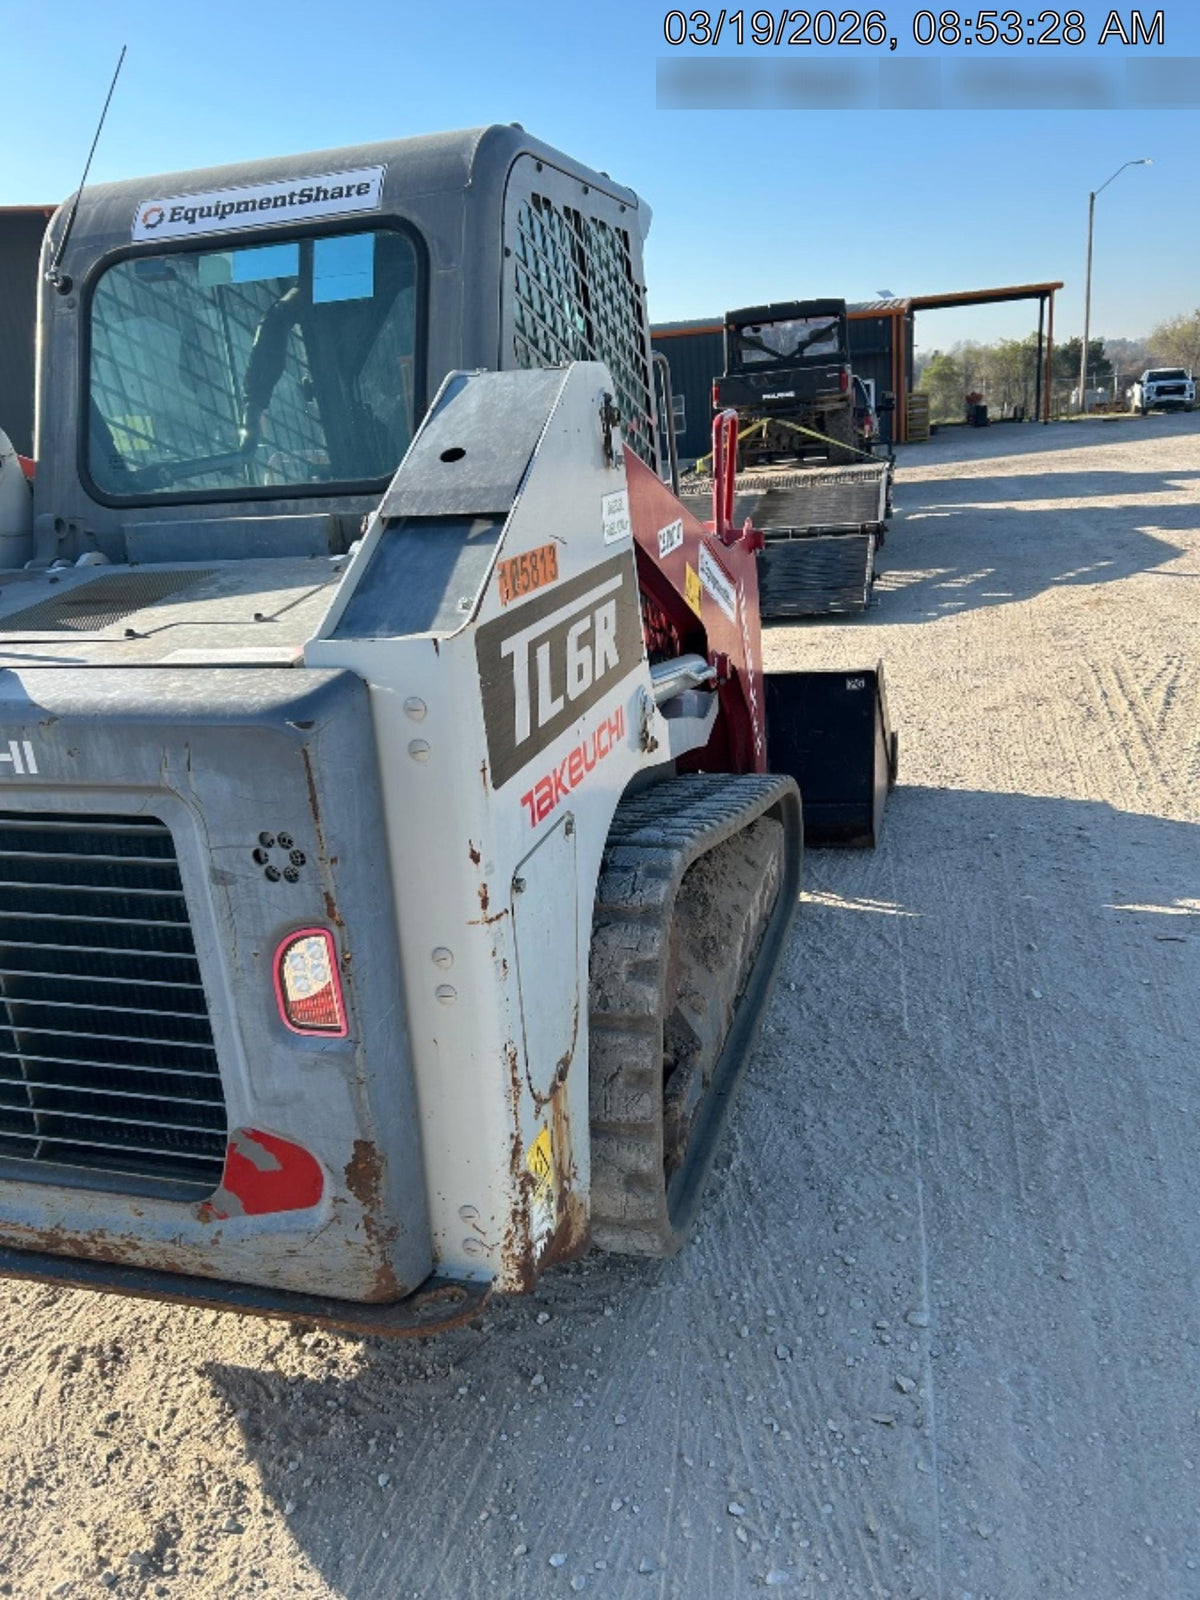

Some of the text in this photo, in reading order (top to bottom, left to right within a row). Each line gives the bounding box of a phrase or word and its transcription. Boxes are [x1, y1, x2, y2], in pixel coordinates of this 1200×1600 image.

[168, 181, 371, 224] EquipmentShare
[498, 544, 559, 602] 105813
[501, 573, 624, 747] TL6R
